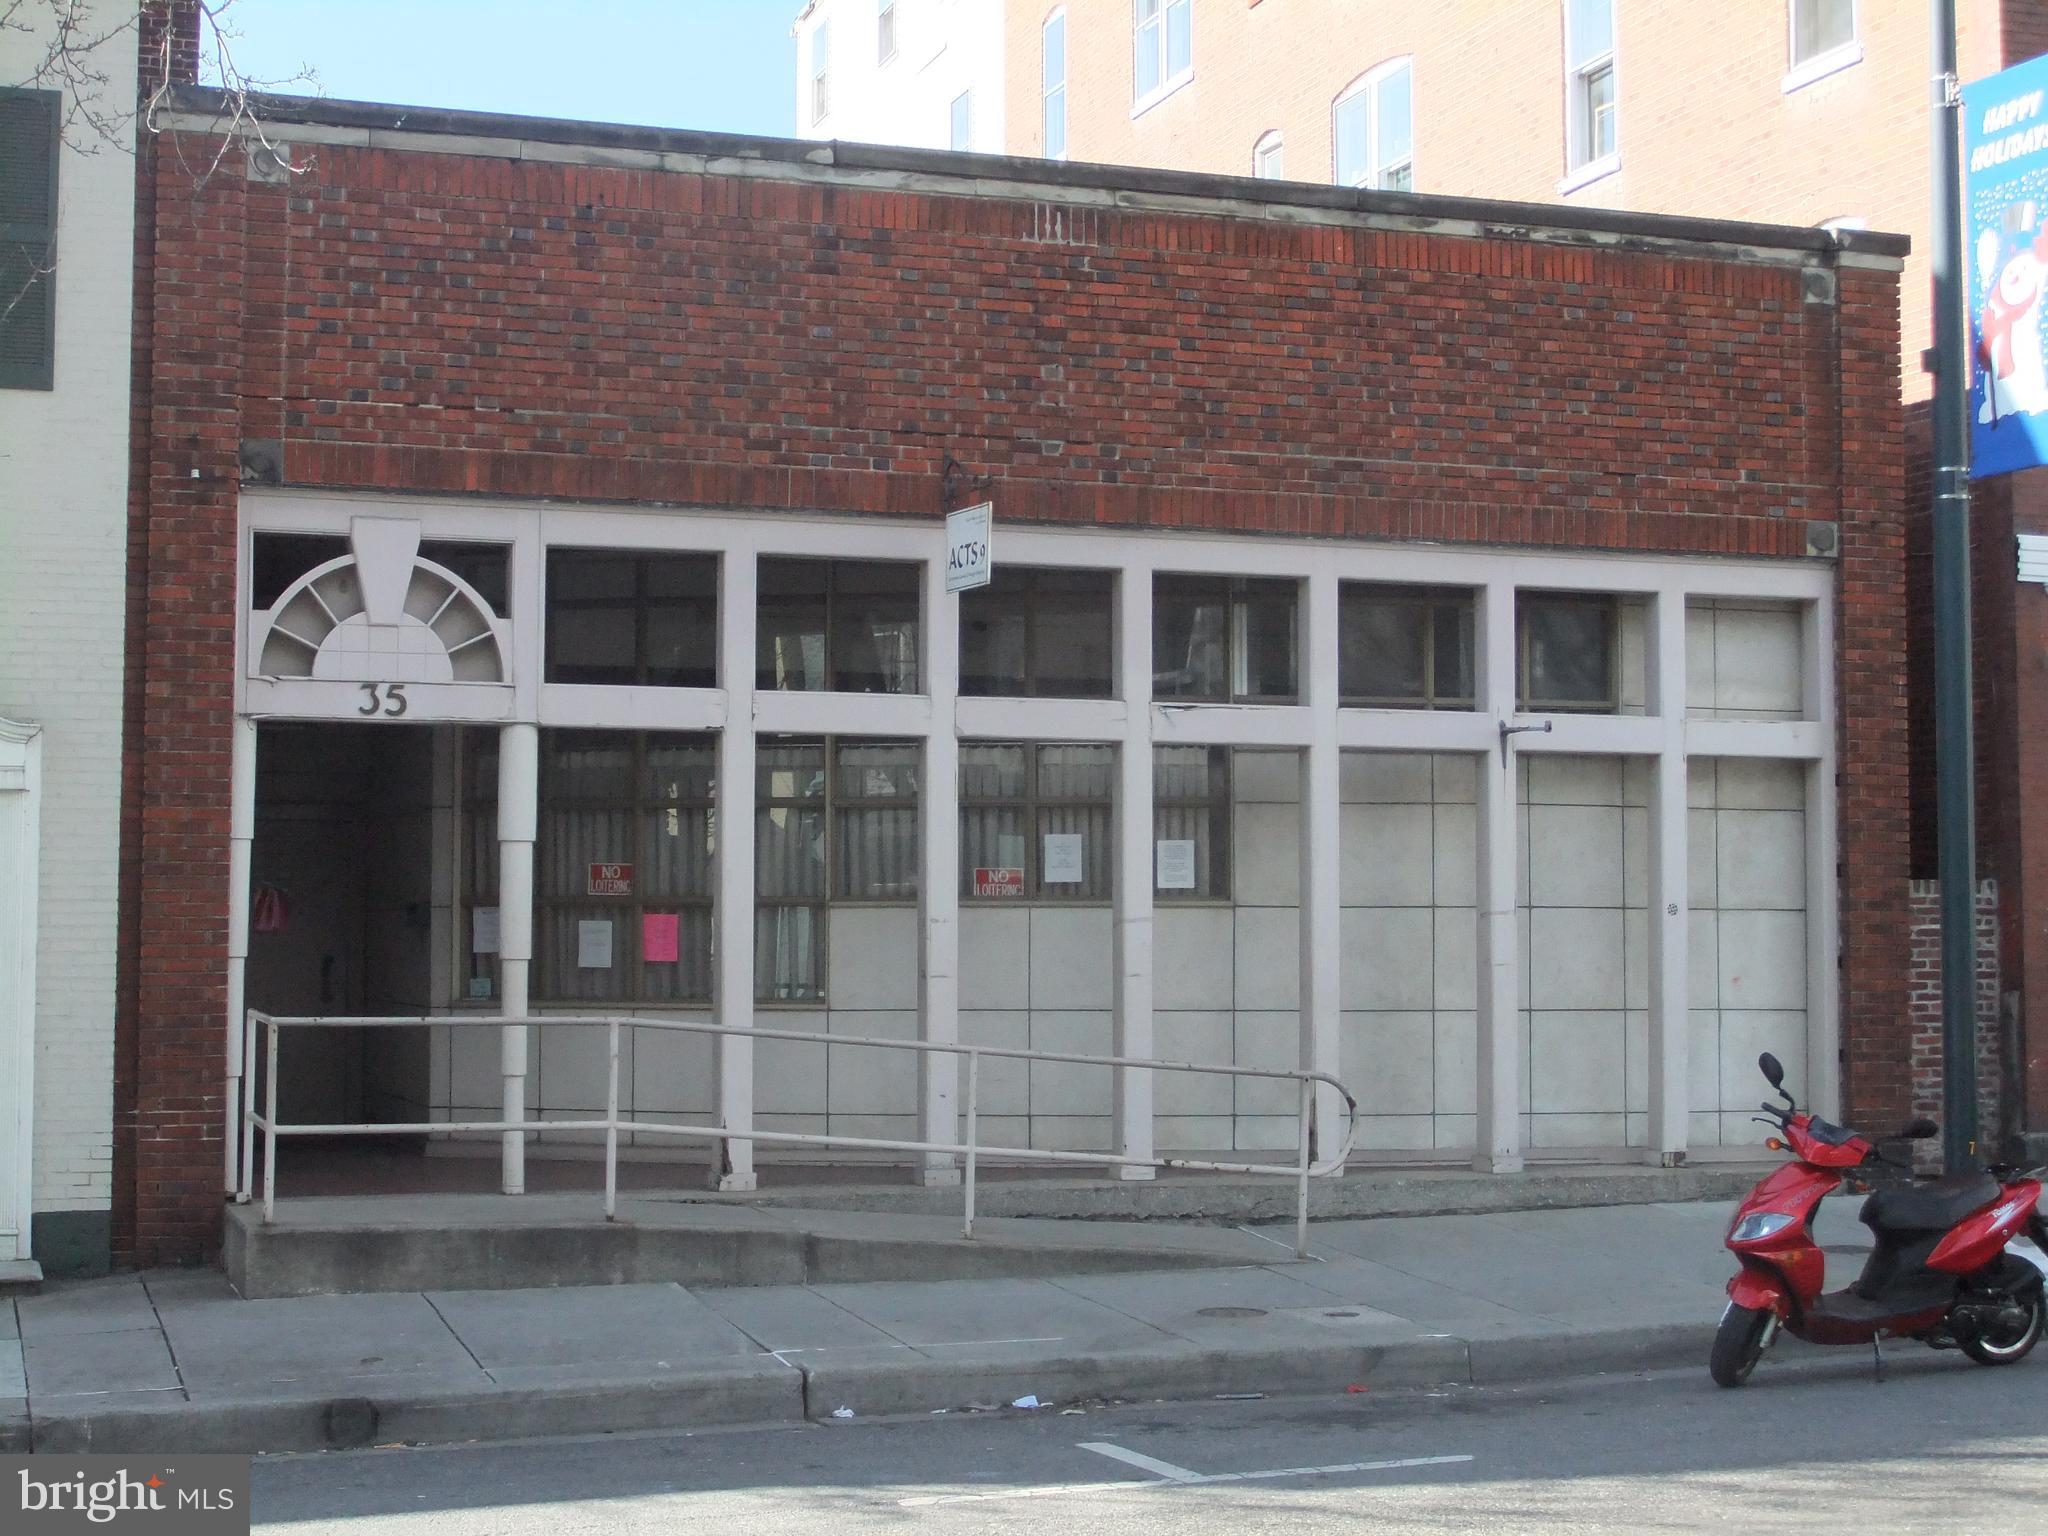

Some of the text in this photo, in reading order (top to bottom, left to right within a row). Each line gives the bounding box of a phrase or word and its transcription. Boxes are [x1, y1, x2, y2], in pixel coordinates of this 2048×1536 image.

[1982, 90, 2043, 134] HAPPY
[949, 541, 986, 570] ACTS 9
[358, 683, 407, 716] 35
[601, 865, 621, 879] NO
[988, 870, 1009, 883] NO
[590, 879, 632, 892] LOITERING
